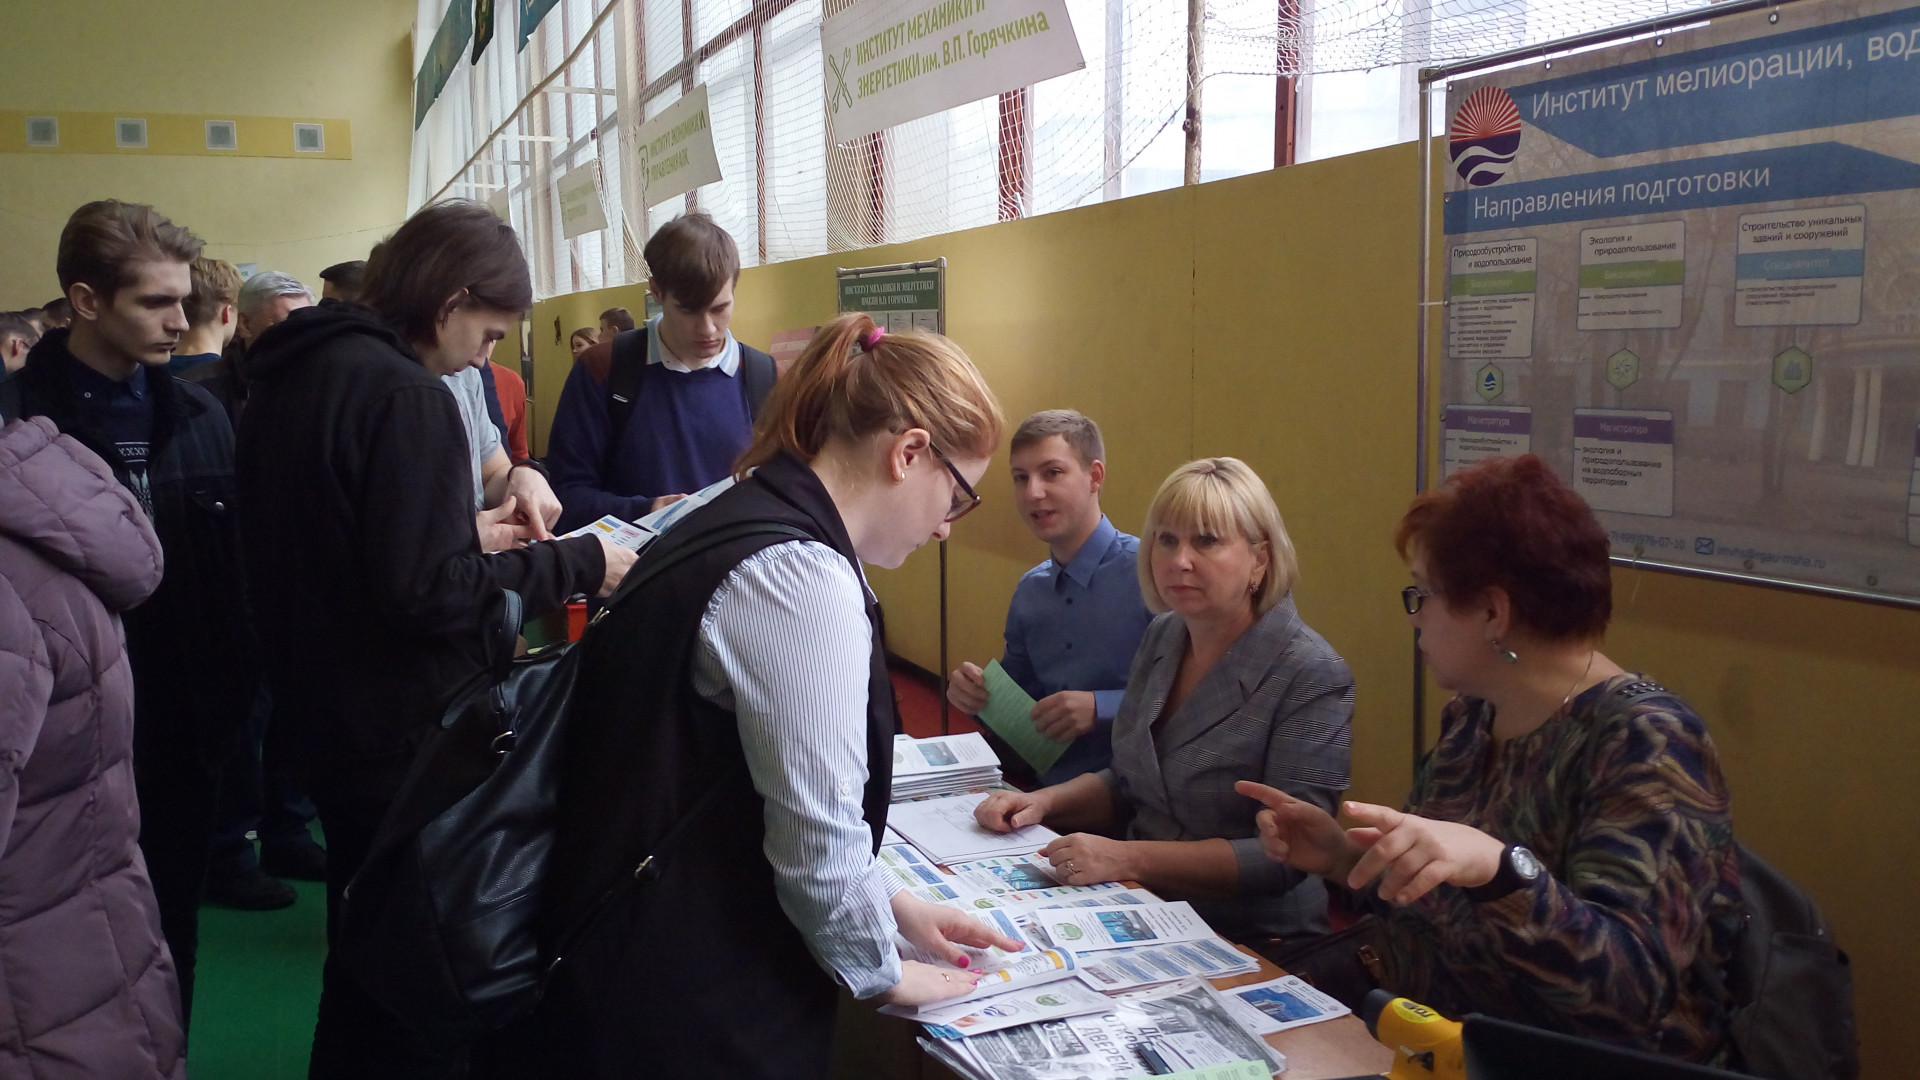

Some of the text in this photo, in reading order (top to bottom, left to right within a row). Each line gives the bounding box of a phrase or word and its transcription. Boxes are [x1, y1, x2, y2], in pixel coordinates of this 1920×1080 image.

[856, 21, 905, 66] ИНСТИТУТ
[907, 0, 975, 44] МЕХАНИКИ
[857, 10, 1050, 100] ЭНЕРГЕТИКИ им. В.П. Горячкина
[1532, 76, 1648, 120] Институт
[1655, 44, 1854, 97] мелиорации,
[1473, 166, 1771, 221] Направления подготовки
[1589, 236, 1625, 246] Экология
[1741, 214, 1863, 232] Строительство уникальных
[1753, 232, 1784, 243] зданий
[1793, 227, 1849, 242] сооружений
[1594, 242, 1677, 257] природопользование
[1078, 1026, 1135, 1072] ДВЕРЕЙ
